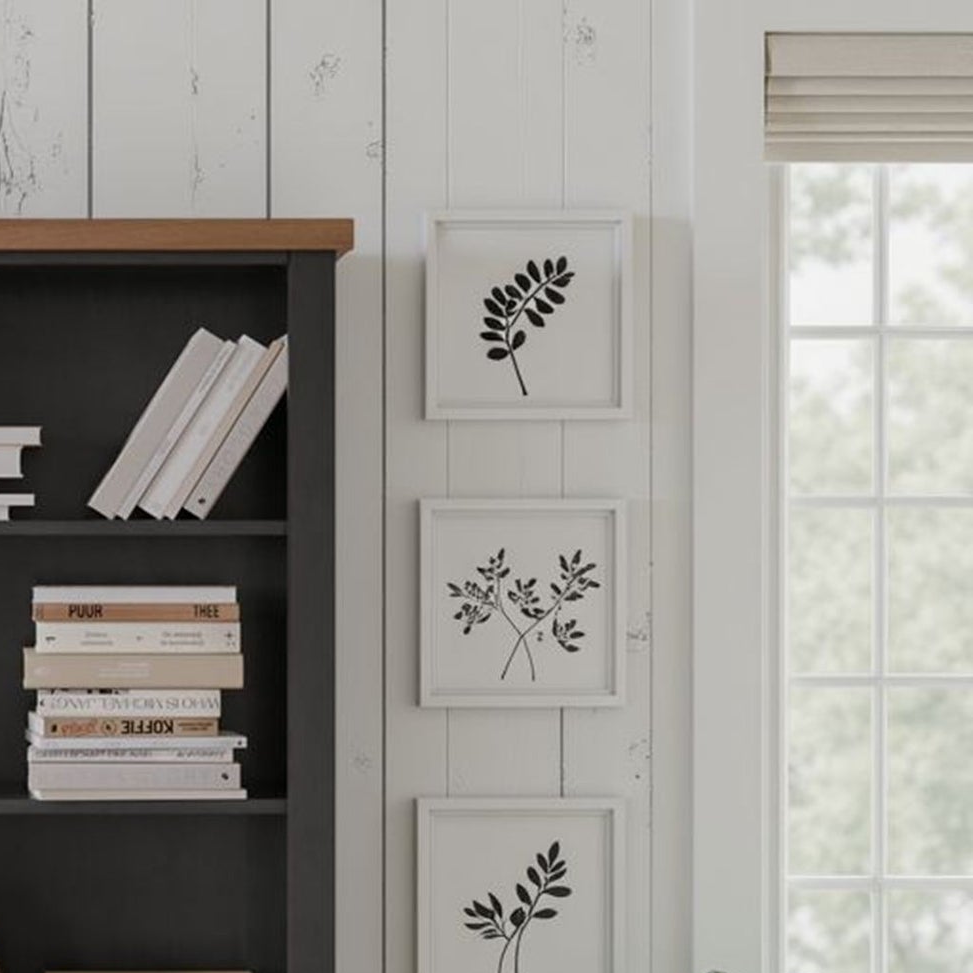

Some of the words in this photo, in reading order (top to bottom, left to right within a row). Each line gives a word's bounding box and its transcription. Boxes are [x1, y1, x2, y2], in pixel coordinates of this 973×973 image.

[68, 604, 103, 618] PUUR
[193, 604, 220, 618] THEE
[101, 696, 164, 710] MICHAEL
[166, 696, 179, 710] IS
[182, 696, 219, 710] WHO
[121, 720, 174, 734] KOFFIE
